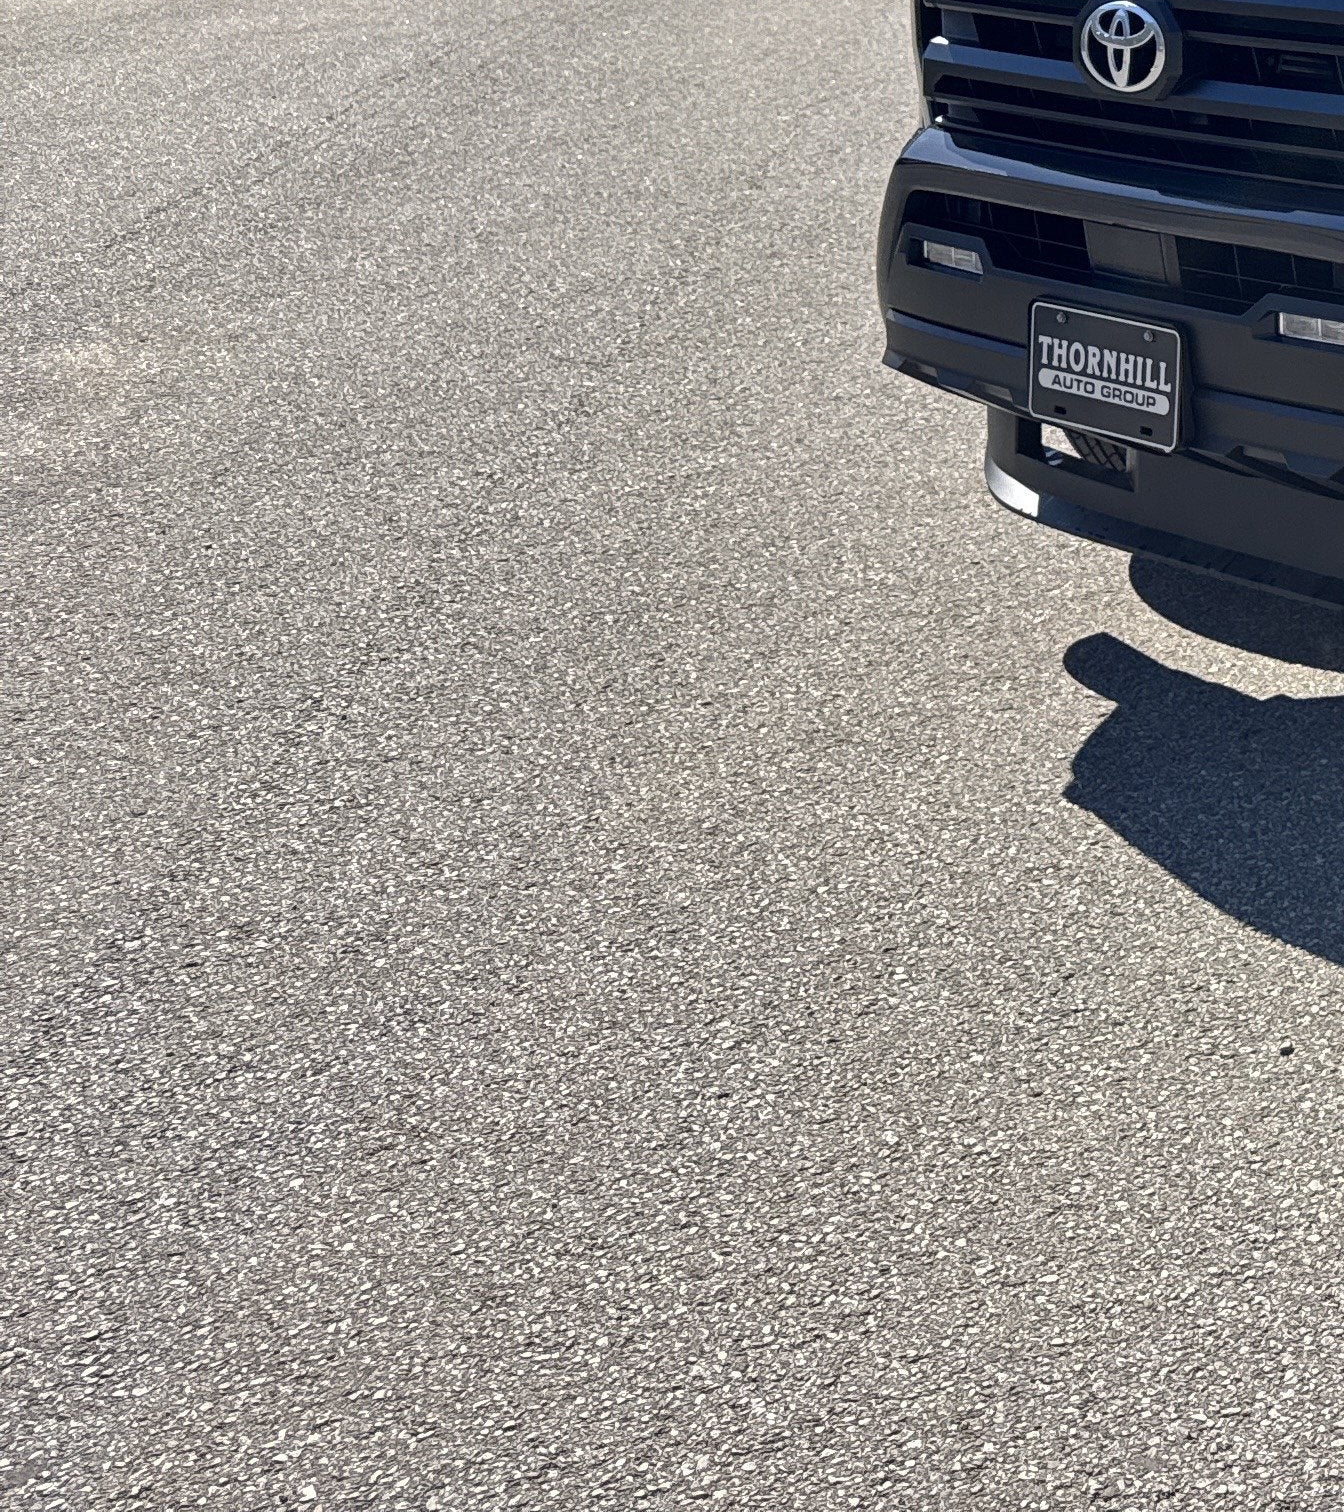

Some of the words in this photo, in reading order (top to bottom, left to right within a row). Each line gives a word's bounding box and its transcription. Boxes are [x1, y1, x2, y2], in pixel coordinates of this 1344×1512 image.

[1038, 334, 1172, 393] THORNHILL
[1051, 373, 1096, 395] AUTO
[1100, 384, 1157, 408] GROUP
